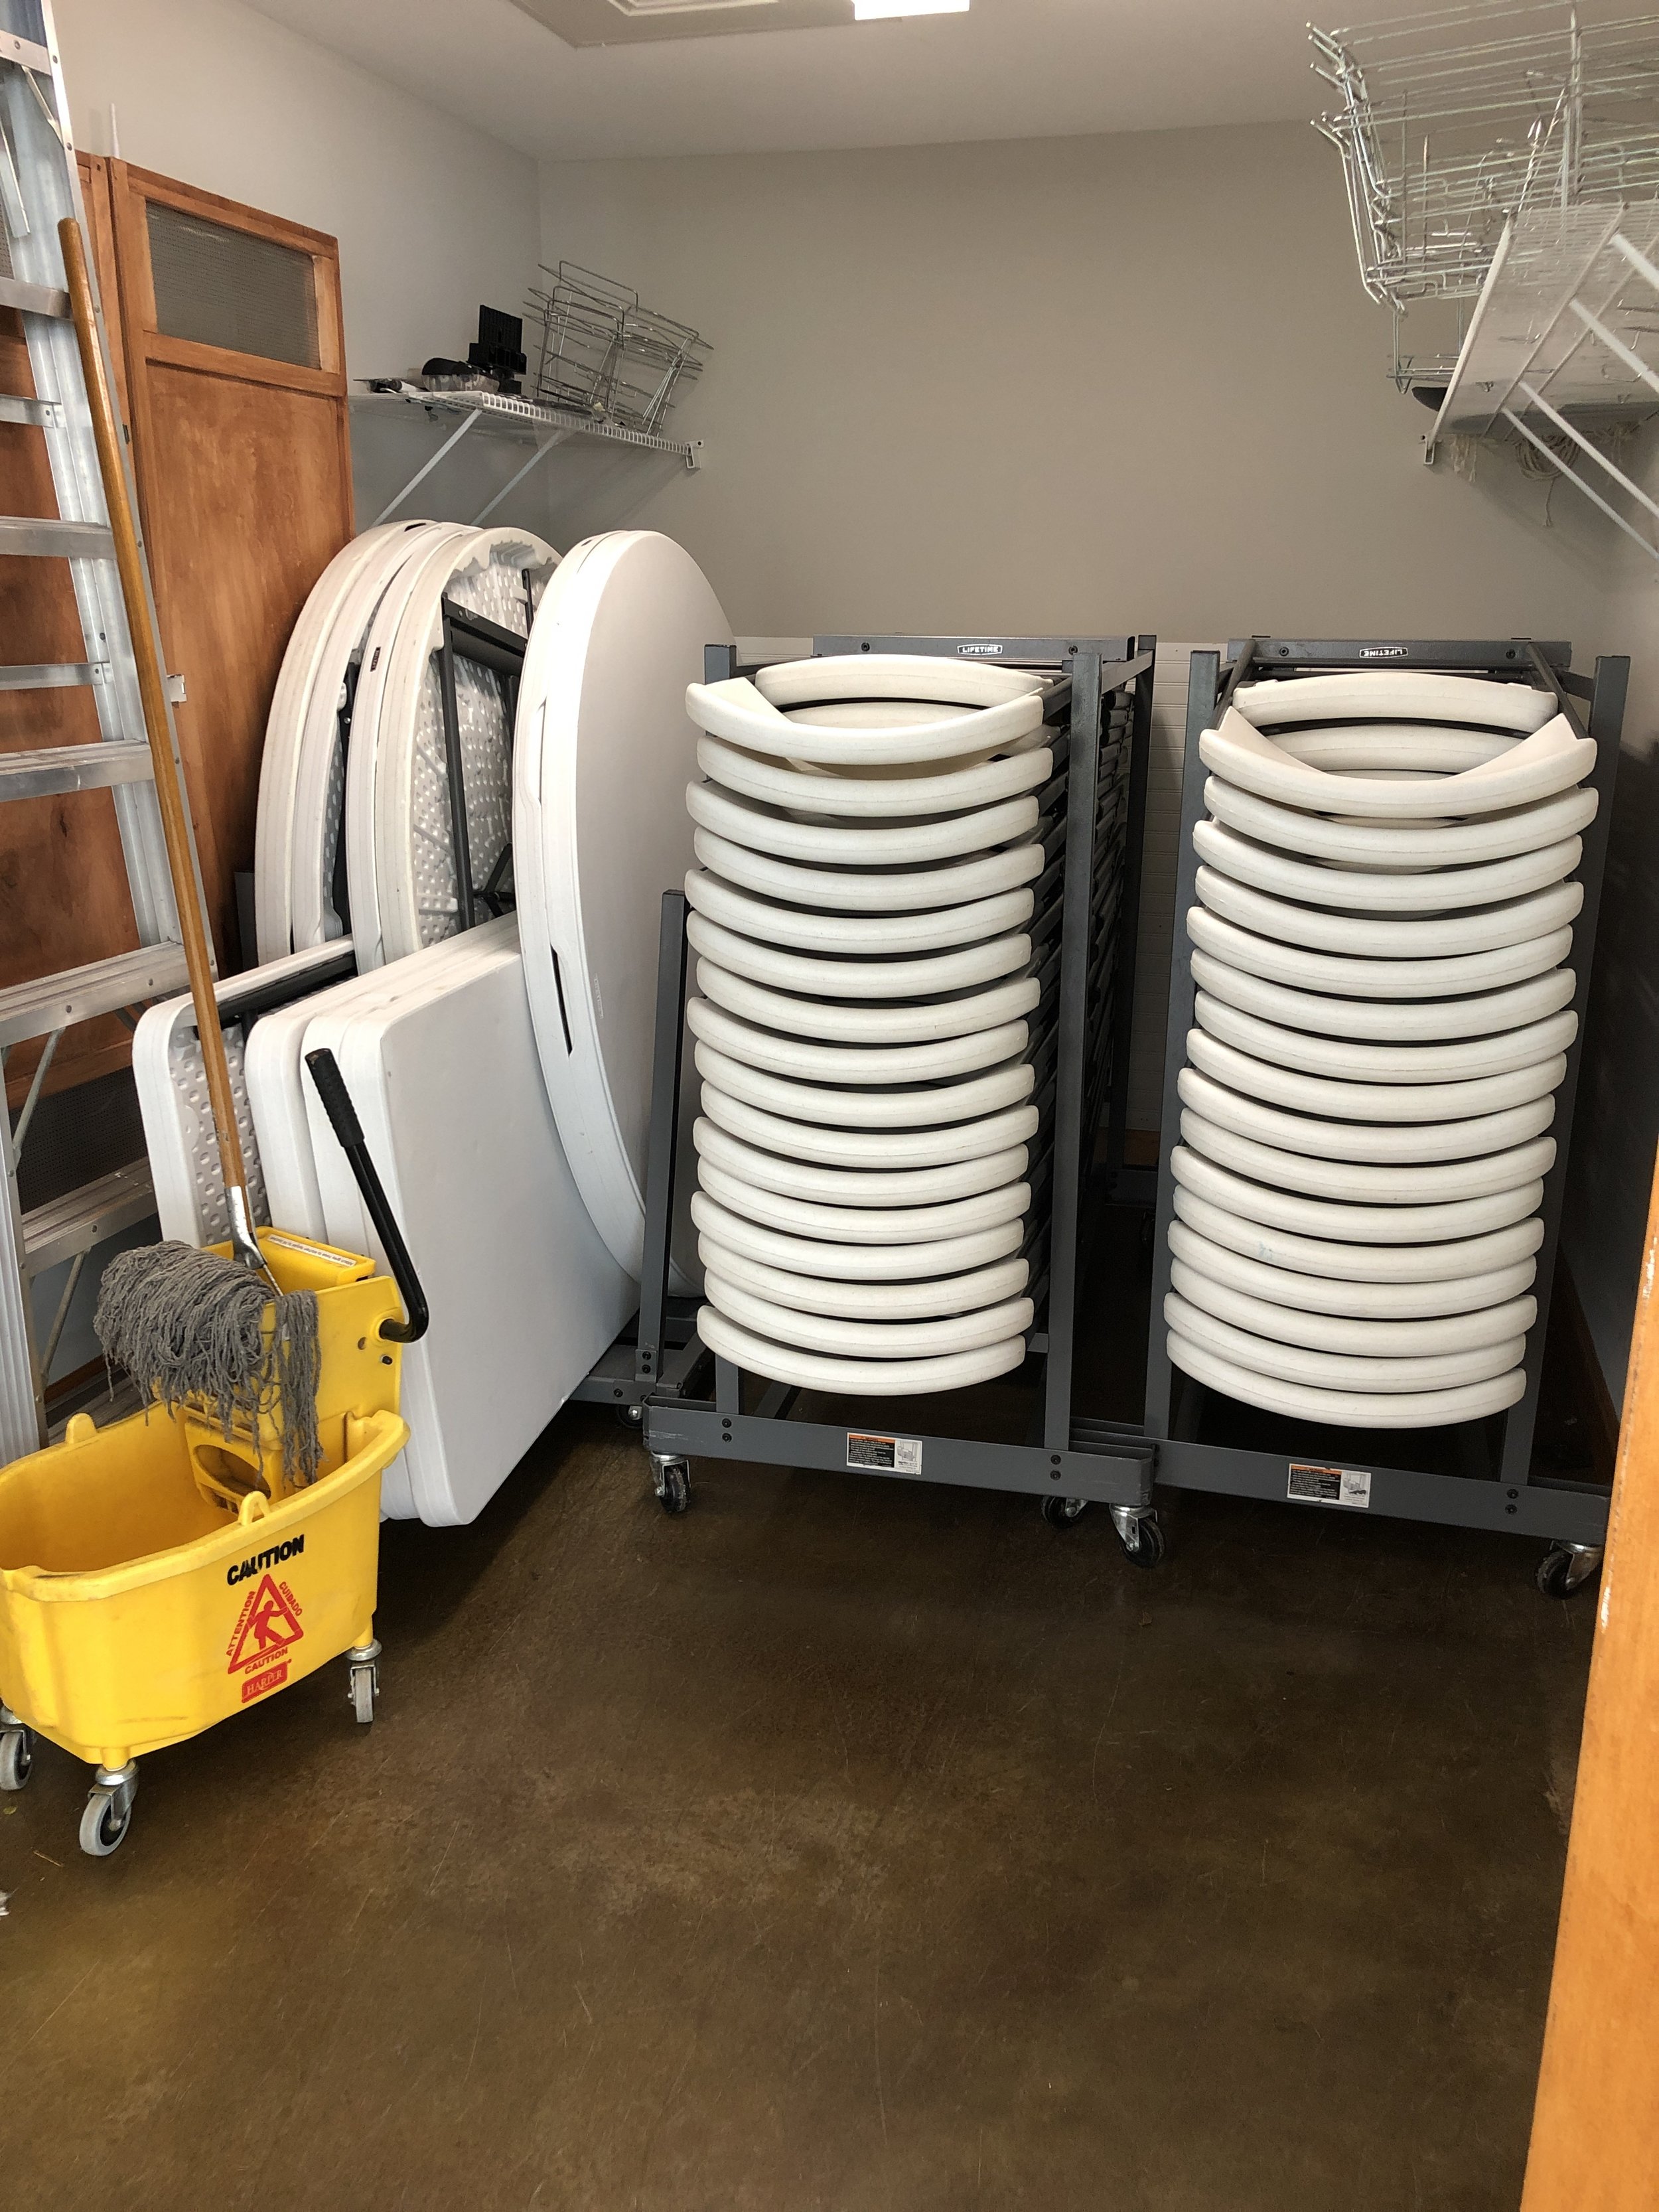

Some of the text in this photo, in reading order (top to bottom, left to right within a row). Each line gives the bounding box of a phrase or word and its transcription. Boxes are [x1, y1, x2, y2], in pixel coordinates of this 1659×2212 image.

[227, 1534, 304, 1585] CAUTION
[279, 1581, 303, 1617] CUIDADO
[226, 1591, 255, 1656] ATTENTION
[244, 1647, 288, 1674] CAUTION
[246, 1669, 283, 1695] HARPER
